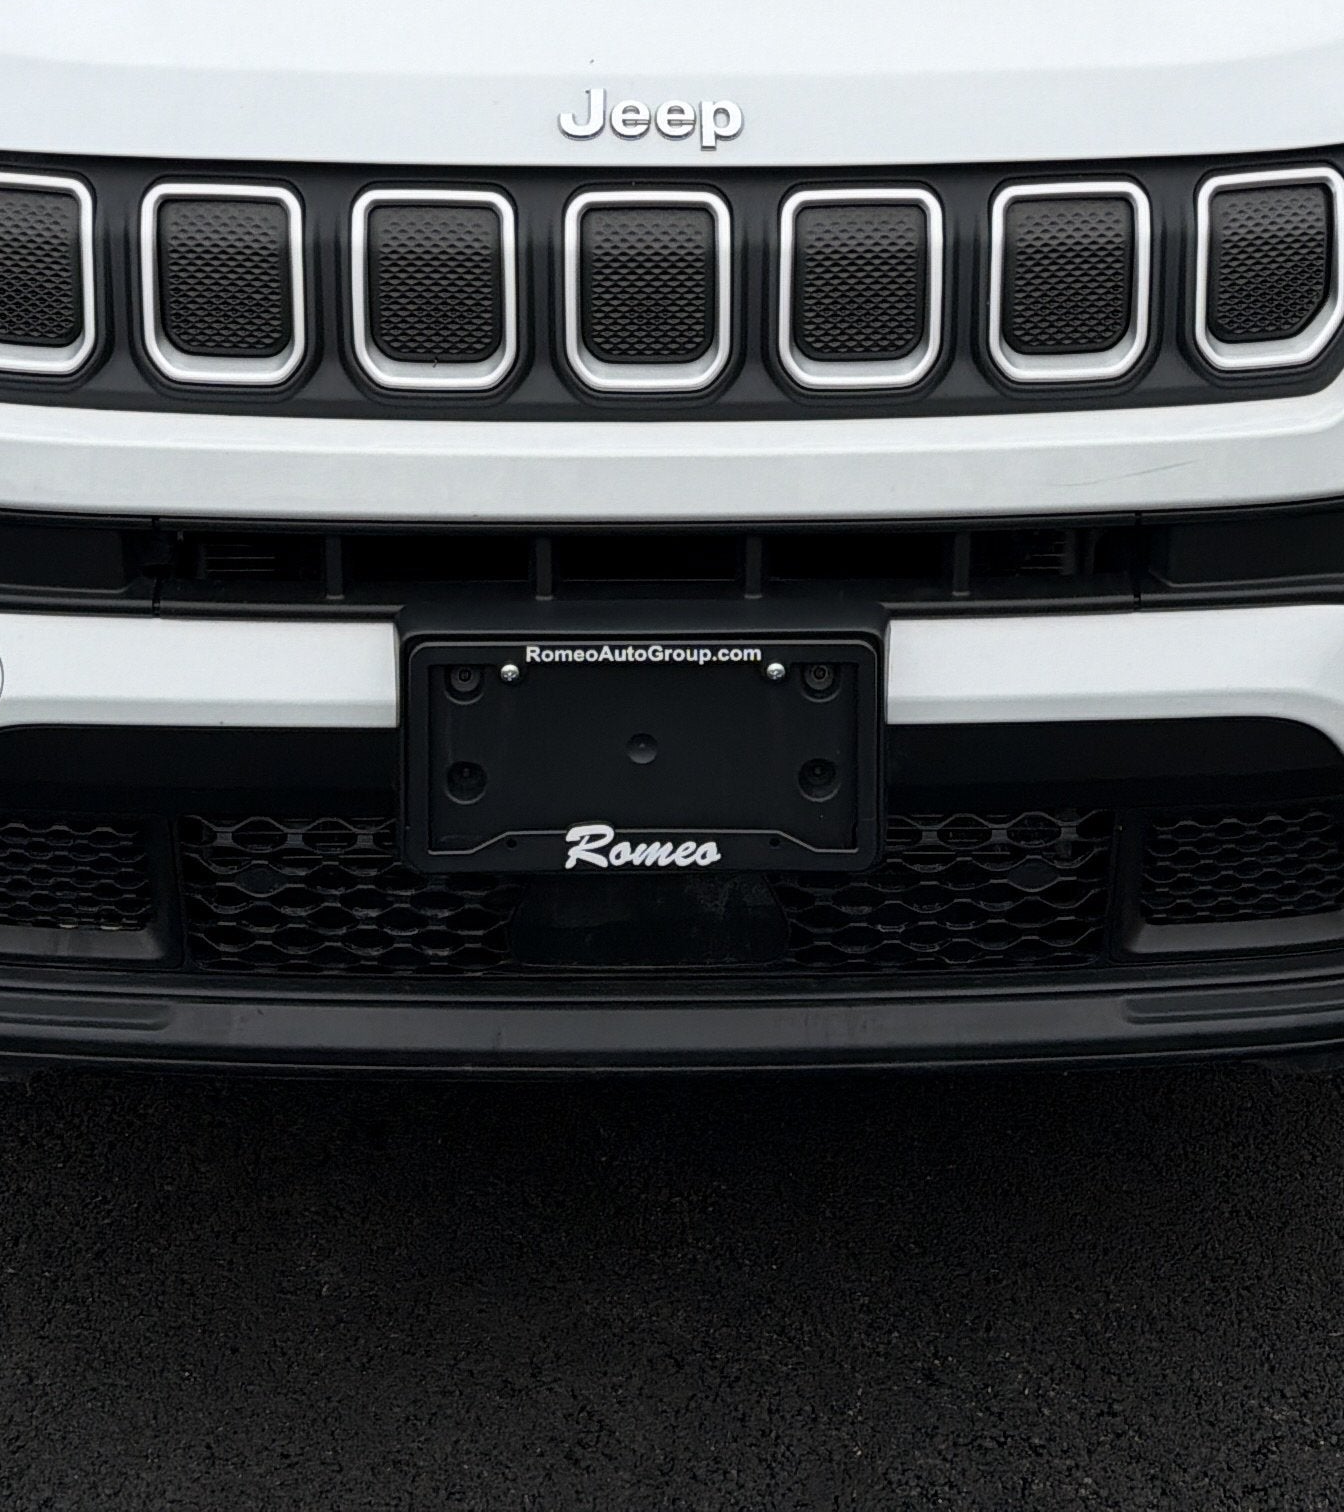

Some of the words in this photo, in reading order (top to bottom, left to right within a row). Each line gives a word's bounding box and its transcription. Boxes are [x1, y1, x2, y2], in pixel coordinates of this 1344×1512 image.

[557, 87, 744, 151] Jeep
[525, 645, 762, 666] RomeoAutoGroup.com
[563, 822, 722, 870] Romeo
